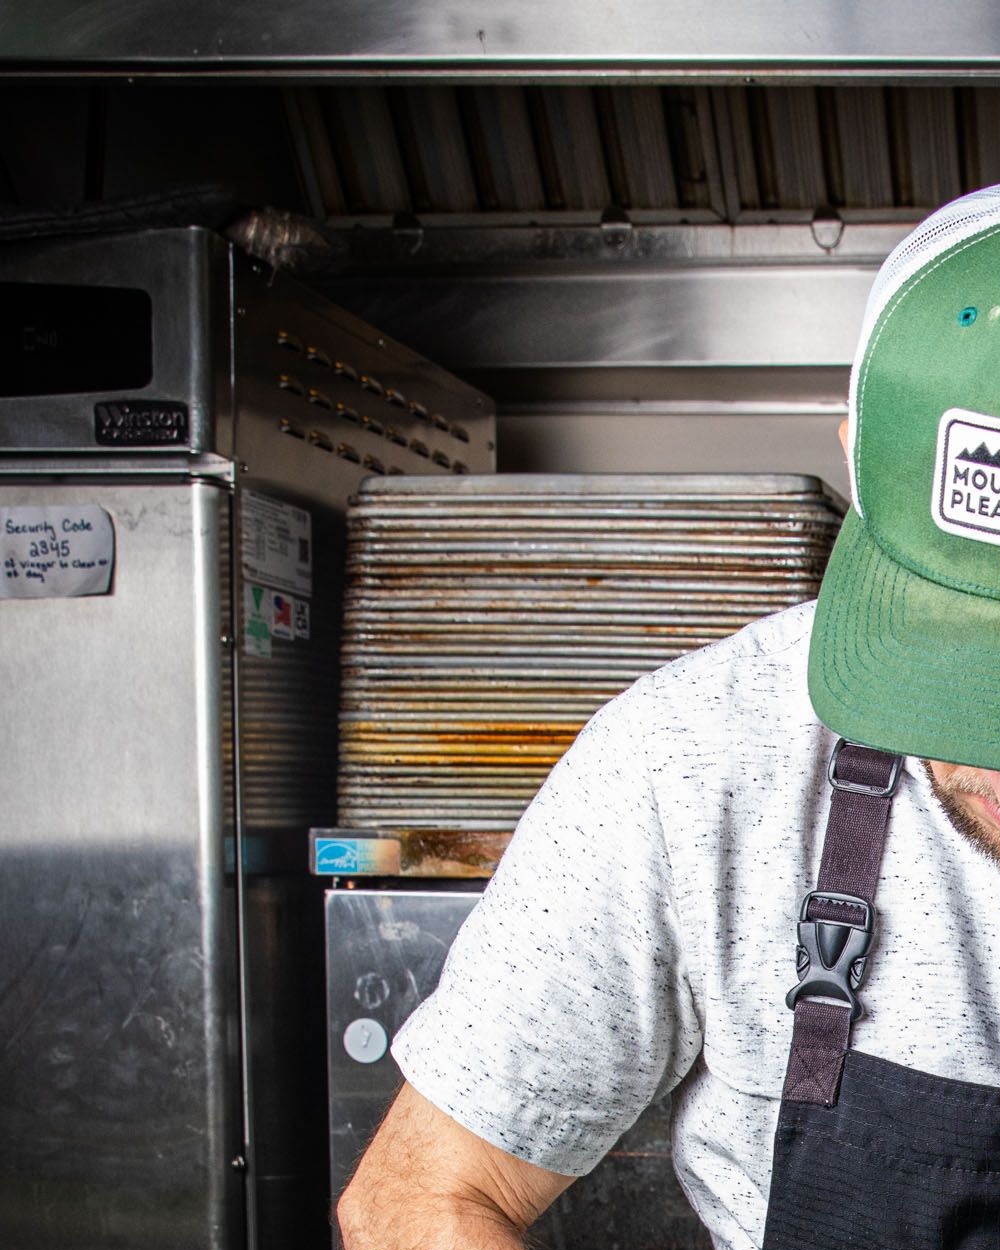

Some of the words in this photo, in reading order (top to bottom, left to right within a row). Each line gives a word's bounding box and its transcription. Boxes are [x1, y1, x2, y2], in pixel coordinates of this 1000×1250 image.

[6, 518, 56, 541] Security
[62, 518, 93, 533] Code
[30, 540, 70, 558] 2345
